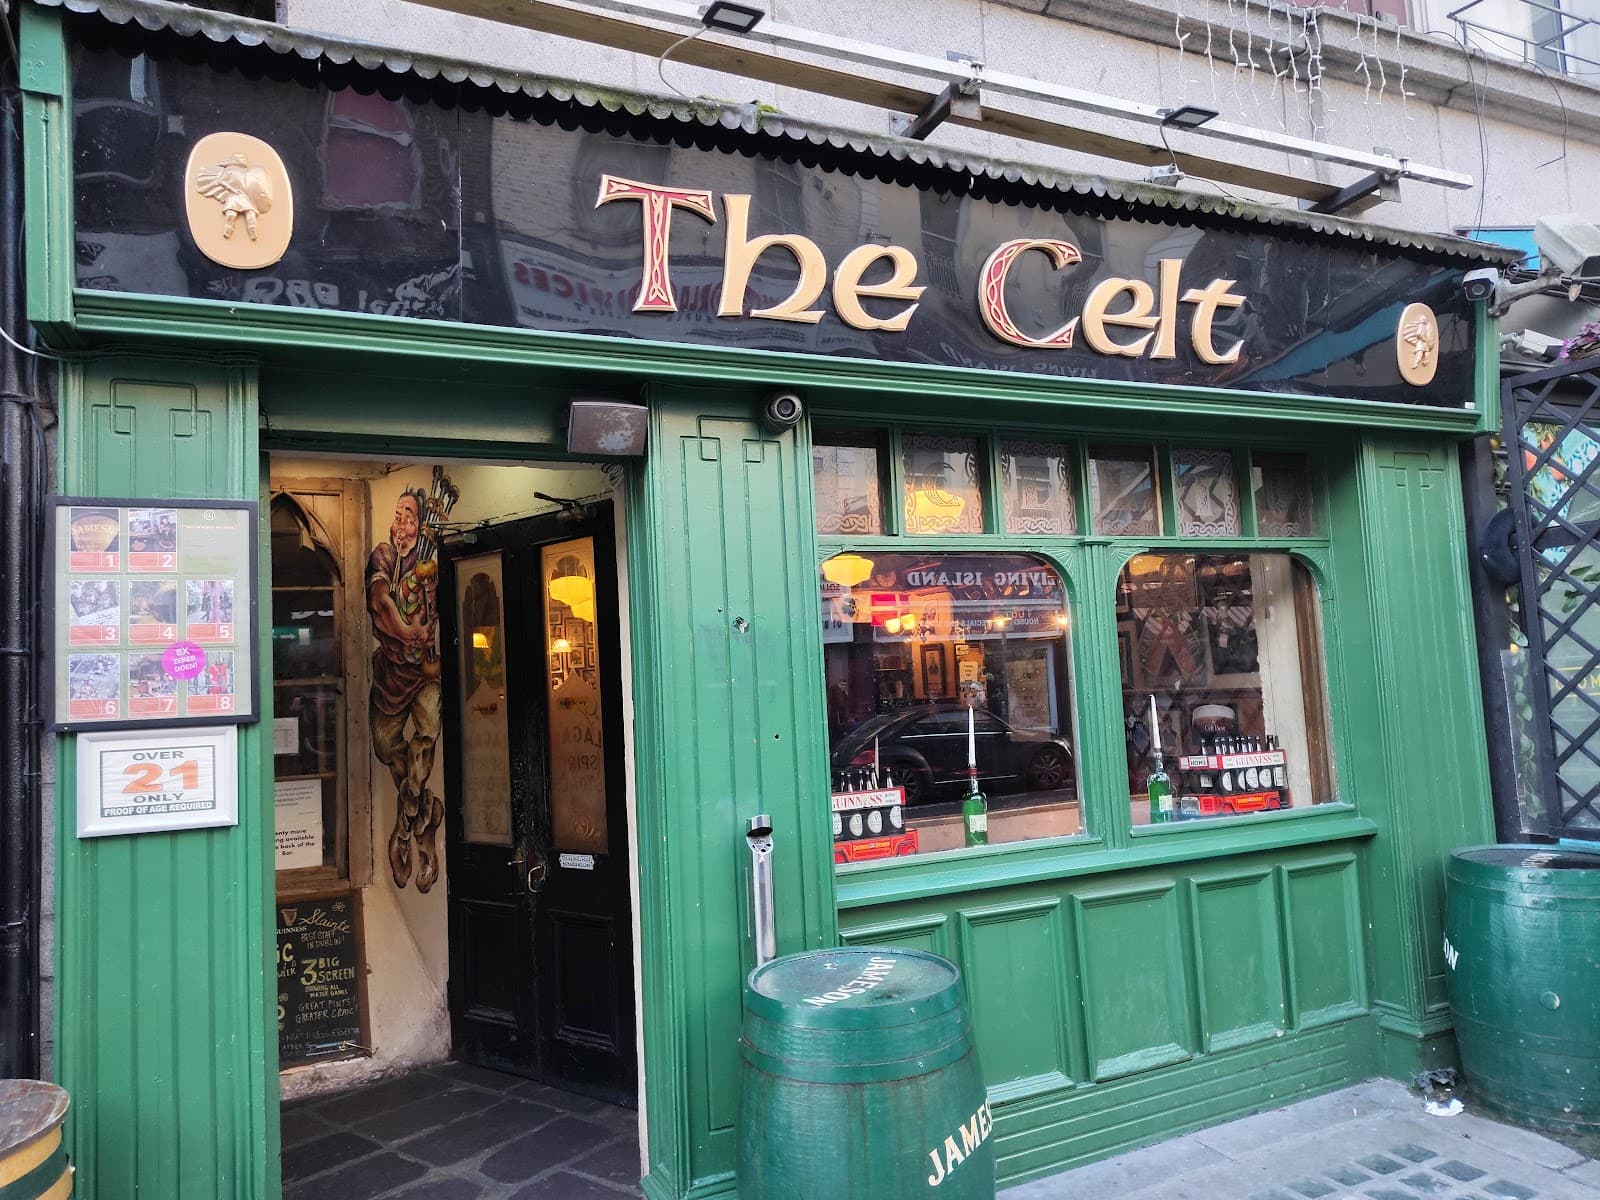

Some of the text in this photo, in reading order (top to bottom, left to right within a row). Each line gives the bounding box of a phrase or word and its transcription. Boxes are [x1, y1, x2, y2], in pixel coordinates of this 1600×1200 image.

[594, 174, 1248, 365] The Celt
[105, 554, 115, 568] 1
[162, 554, 173, 568] 2
[105, 627, 116, 640] 3
[163, 626, 174, 639] 4
[219, 625, 230, 638] 5
[105, 701, 116, 714] 6
[163, 699, 174, 712] 7
[219, 696, 230, 709] 8
[132, 750, 184, 761] OVER
[121, 760, 199, 794] 21
[133, 792, 184, 803] ONLY
[104, 800, 213, 817] PROOF OF AGE REQUIRED
[319, 957, 340, 969] BIG
[803, 956, 897, 1008] JAMESON
